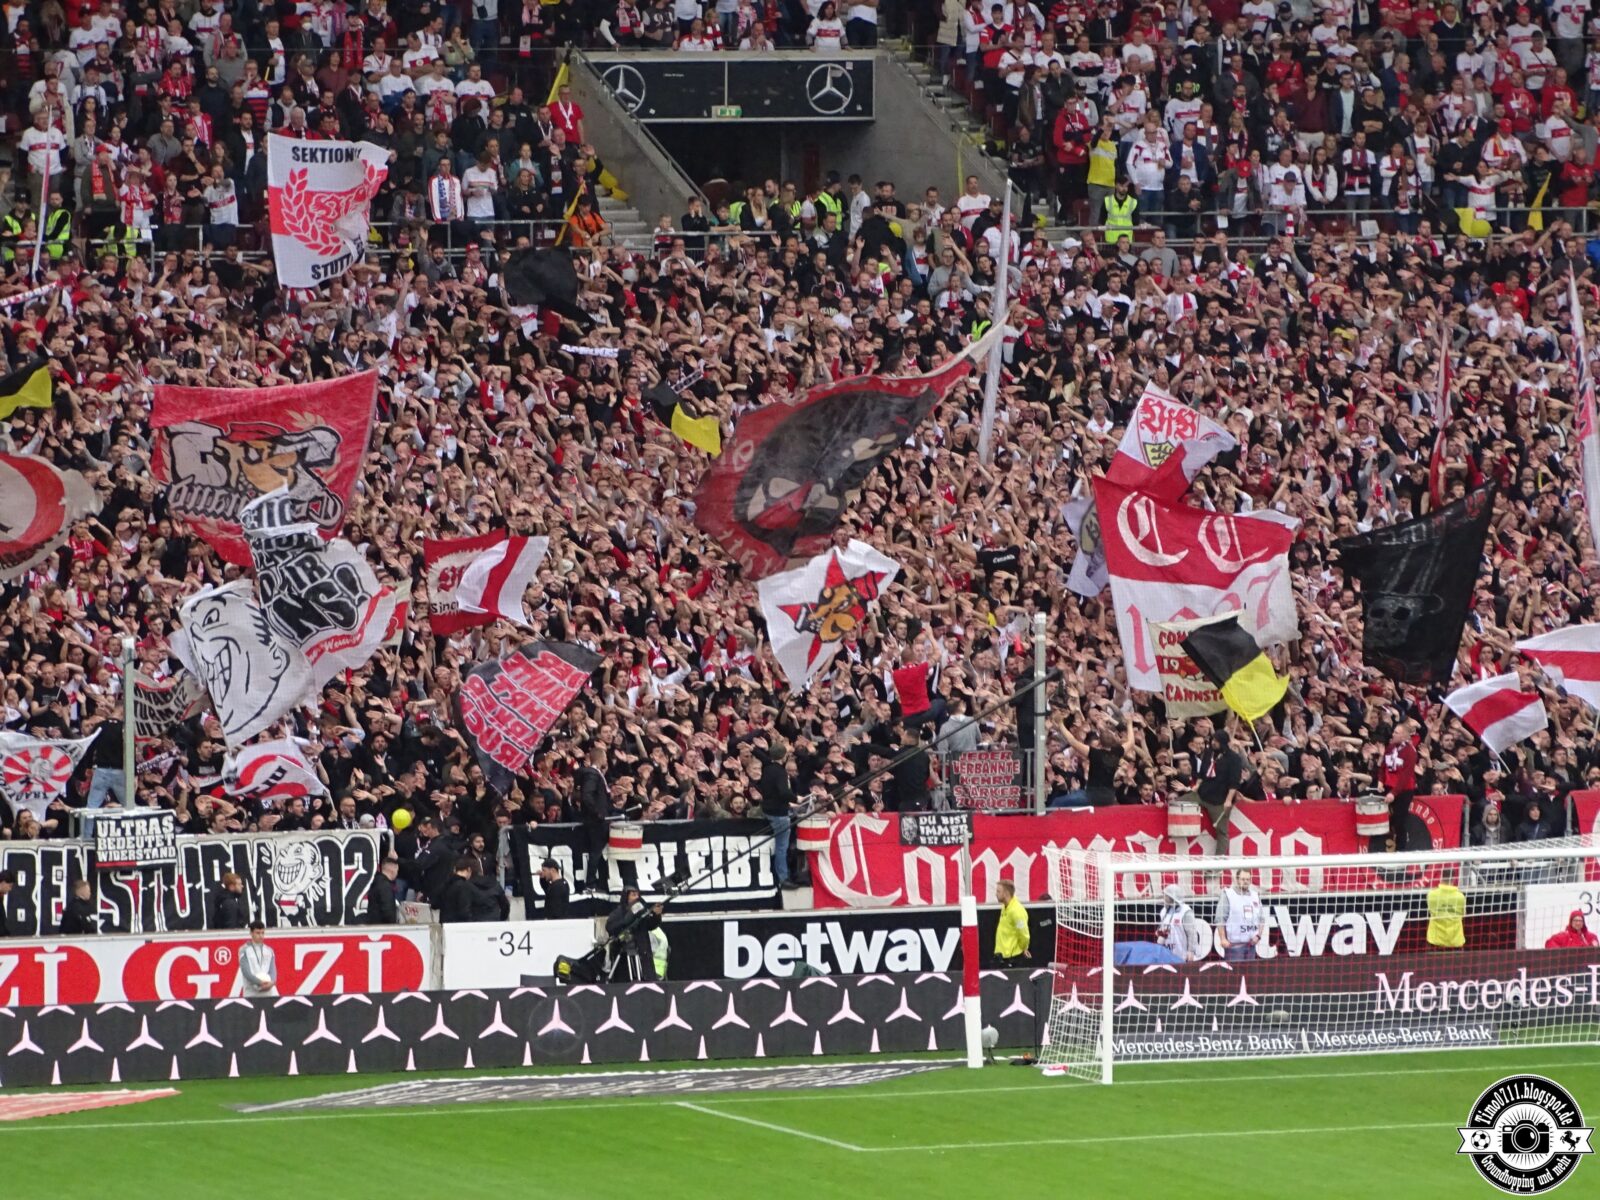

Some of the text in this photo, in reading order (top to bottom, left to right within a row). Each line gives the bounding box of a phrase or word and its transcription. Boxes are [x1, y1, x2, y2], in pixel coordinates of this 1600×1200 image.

[1139, 397, 1198, 440] VfB
[959, 751, 1013, 761] JEDER
[952, 760, 1020, 775] VERBANNTE
[959, 775, 1014, 785] KEHRT
[96, 815, 174, 838] ULTRAS
[919, 814, 968, 825] DU BIST
[920, 824, 969, 836] IMMER
[97, 832, 175, 851] BEDEUTET
[920, 835, 965, 845] BEI UNS
[97, 845, 176, 862] WIDERSTAND
[500, 931, 533, 956] 34
[723, 920, 961, 979] betway
[1111, 1034, 1296, 1055] Mercedes-Benz Bank
[1312, 1024, 1493, 1049] Mercedes-Benz Bank
